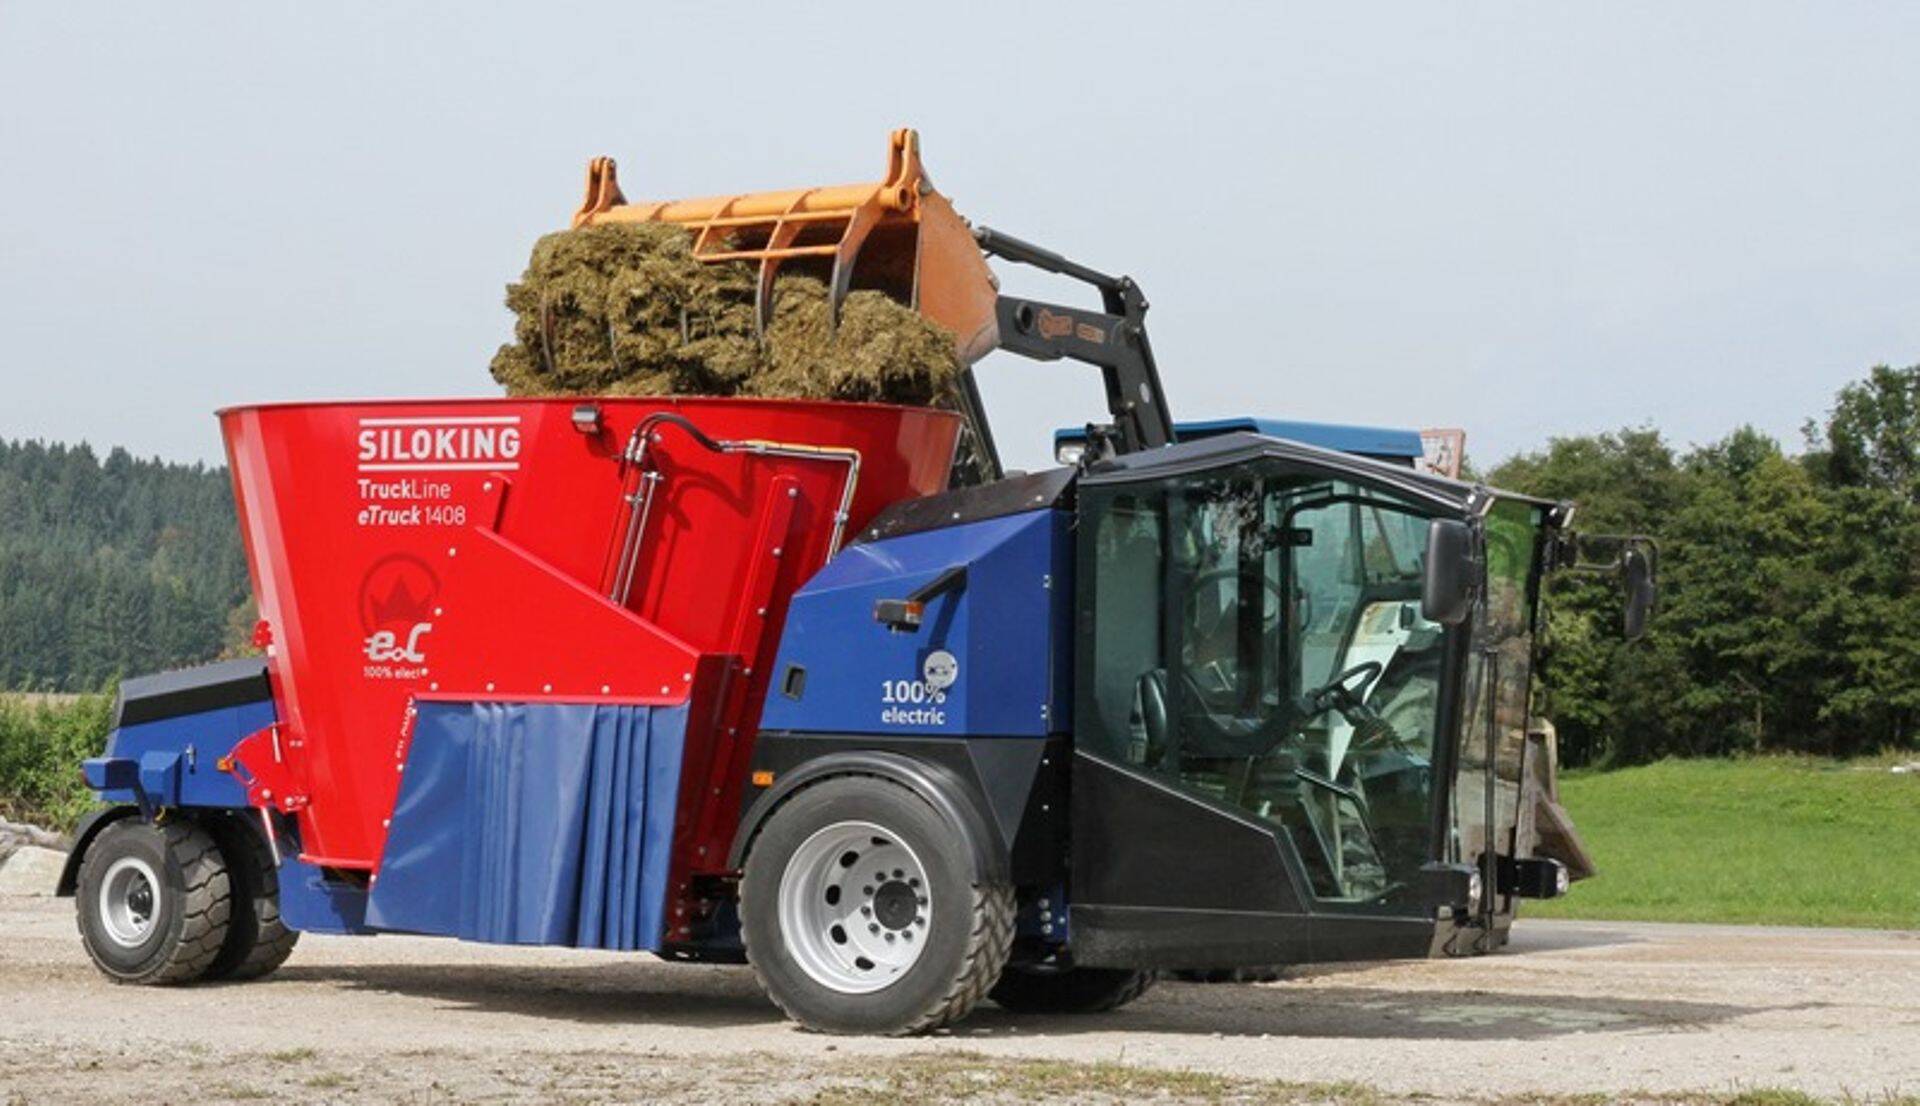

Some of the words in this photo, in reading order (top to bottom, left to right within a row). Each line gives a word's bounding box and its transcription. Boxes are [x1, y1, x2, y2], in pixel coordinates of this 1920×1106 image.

[358, 428, 520, 460] SILOKING
[357, 479, 452, 499] TruckLine
[358, 505, 421, 525] eTruck
[425, 506, 466, 525] 1408
[363, 665, 393, 679] 100%
[882, 680, 946, 704] 100%
[881, 706, 946, 725] electric
